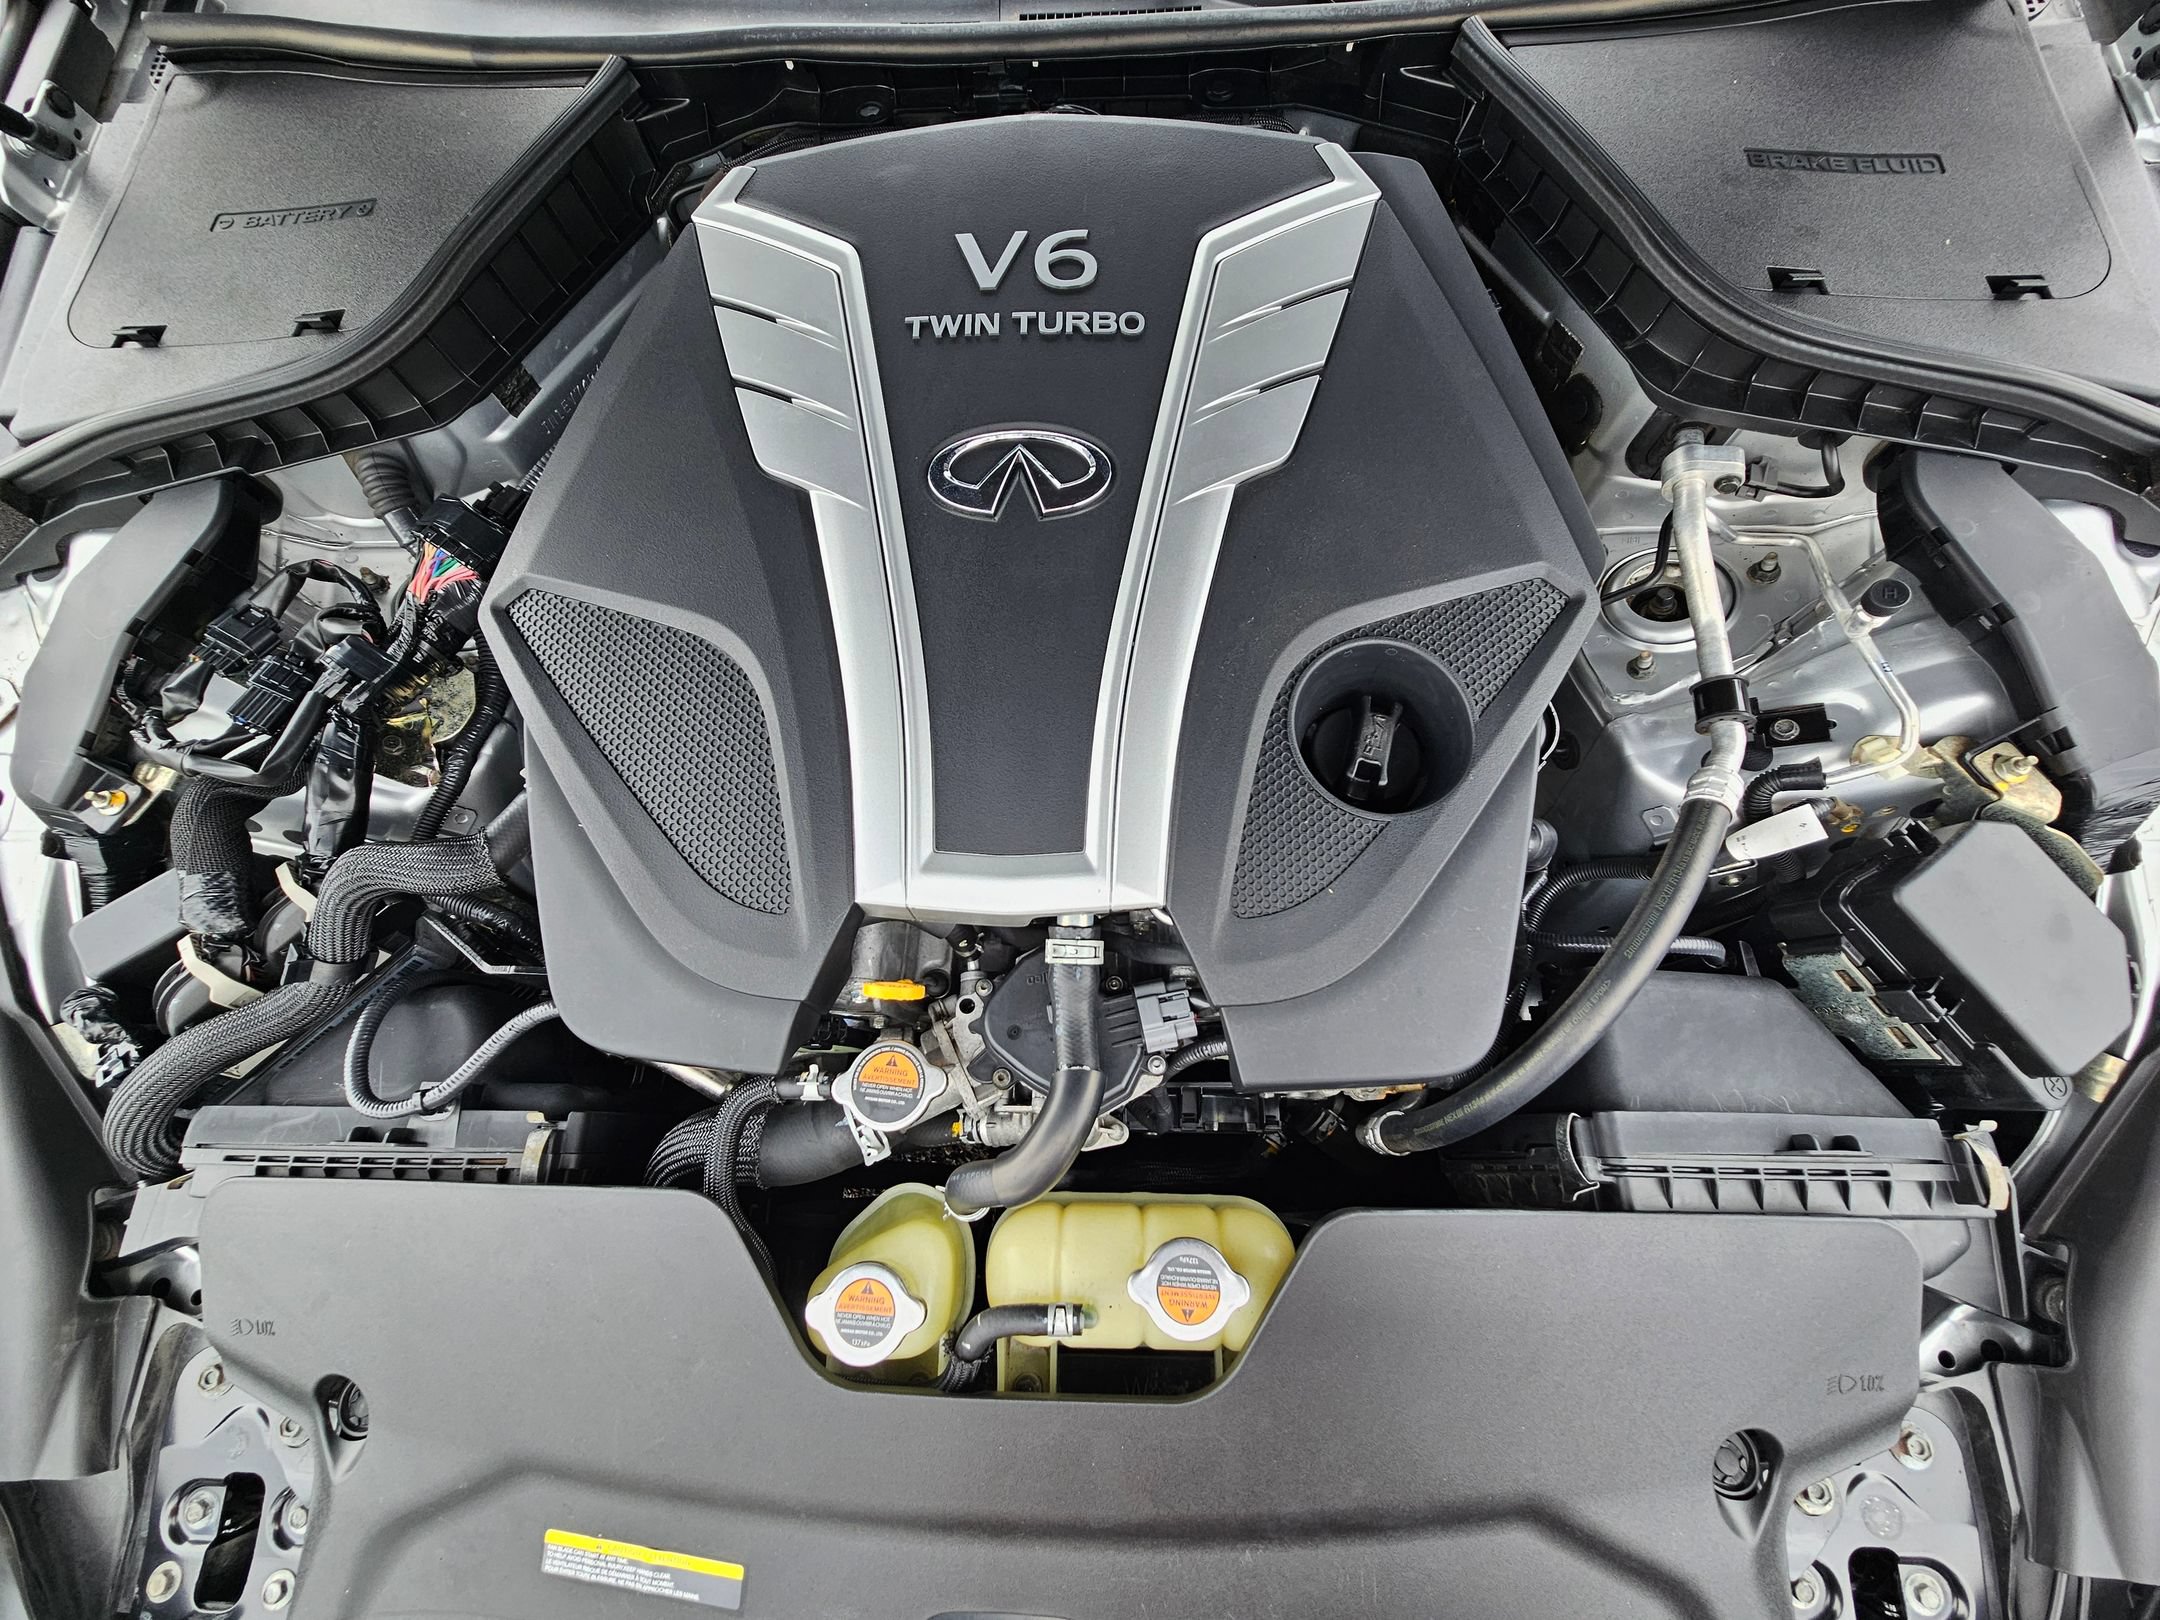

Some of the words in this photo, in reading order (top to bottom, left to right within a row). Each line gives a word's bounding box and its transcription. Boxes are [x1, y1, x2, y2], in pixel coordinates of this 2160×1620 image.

[1746, 151, 1848, 173] BRAKE
[1853, 157, 1938, 174] FLUID
[243, 205, 353, 229] BATTERY
[954, 229, 1098, 291] V6
[904, 311, 1000, 339] TWIN
[1011, 311, 1146, 337] TURBO
[873, 1066, 908, 1076] WARNING
[863, 1074, 915, 1085] AVERTISSEMENT
[848, 1294, 885, 1304] WARNING
[1161, 1290, 1216, 1300] AVERTISSEMENT
[839, 1303, 892, 1313] AVERTISSEMENT
[1169, 1299, 1208, 1309] WARNING
